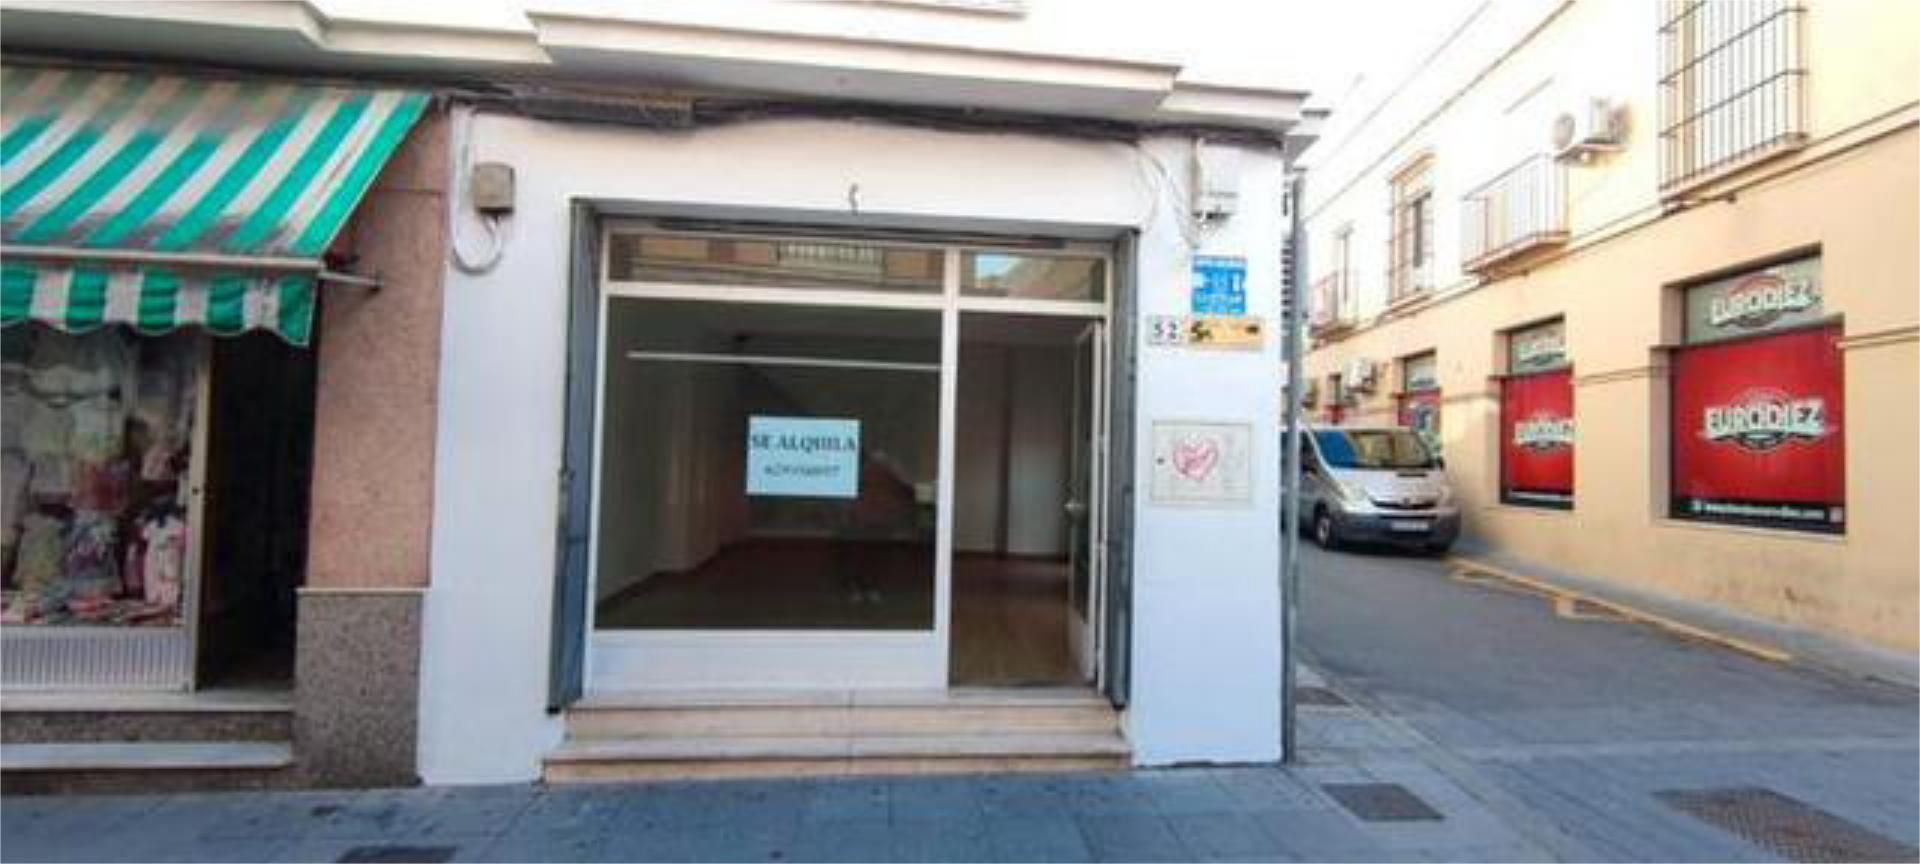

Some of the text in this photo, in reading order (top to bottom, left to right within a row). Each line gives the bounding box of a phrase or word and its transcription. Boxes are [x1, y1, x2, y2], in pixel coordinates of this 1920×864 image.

[1710, 278, 1818, 324] EURODIEZ
[1153, 320, 1178, 340] 52
[1704, 399, 1824, 438] EURODIEZ
[751, 433, 856, 453] SE ALQUILA
